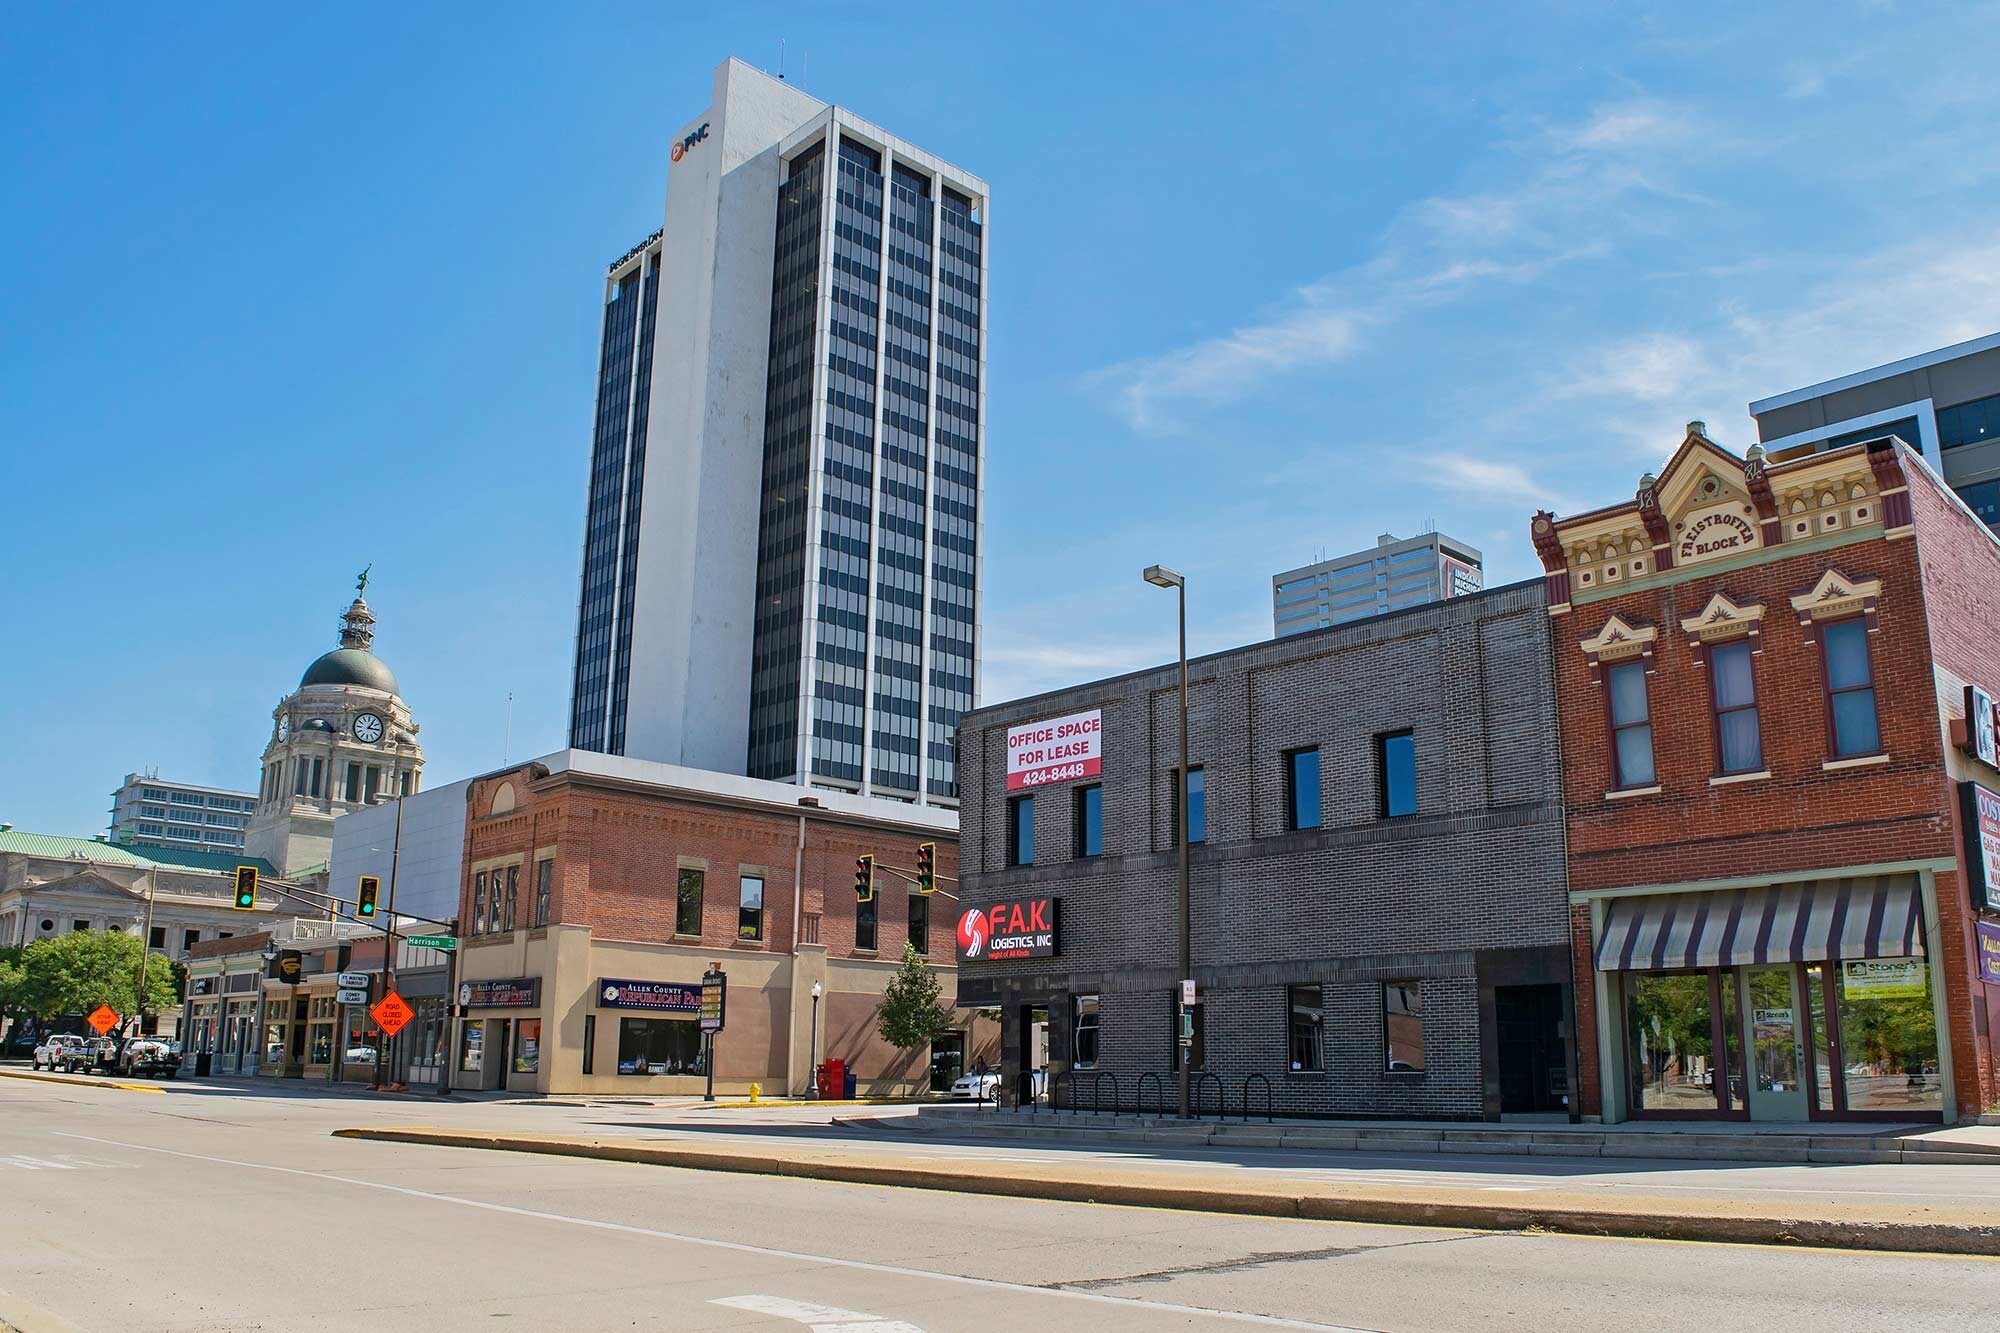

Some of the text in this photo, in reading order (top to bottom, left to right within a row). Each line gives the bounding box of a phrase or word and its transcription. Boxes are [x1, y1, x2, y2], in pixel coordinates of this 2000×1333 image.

[684, 122, 710, 152] PNC
[1639, 490, 1655, 510] 18
[1681, 514, 1754, 557] FREISTROFFER
[1695, 536, 1739, 555] BLOCK
[1008, 717, 1101, 750] OFFICE SPACE
[1018, 740, 1090, 767] FOR LEASE
[1022, 762, 1085, 786] 424-8448
[989, 900, 1051, 935] F.A.K.
[408, 937, 440, 946] Harrison
[991, 935, 1052, 950] LOGISTICS, INC
[618, 987, 681, 1004] REPUBLICAN
[628, 983, 682, 995] ALLEN COUNTY
